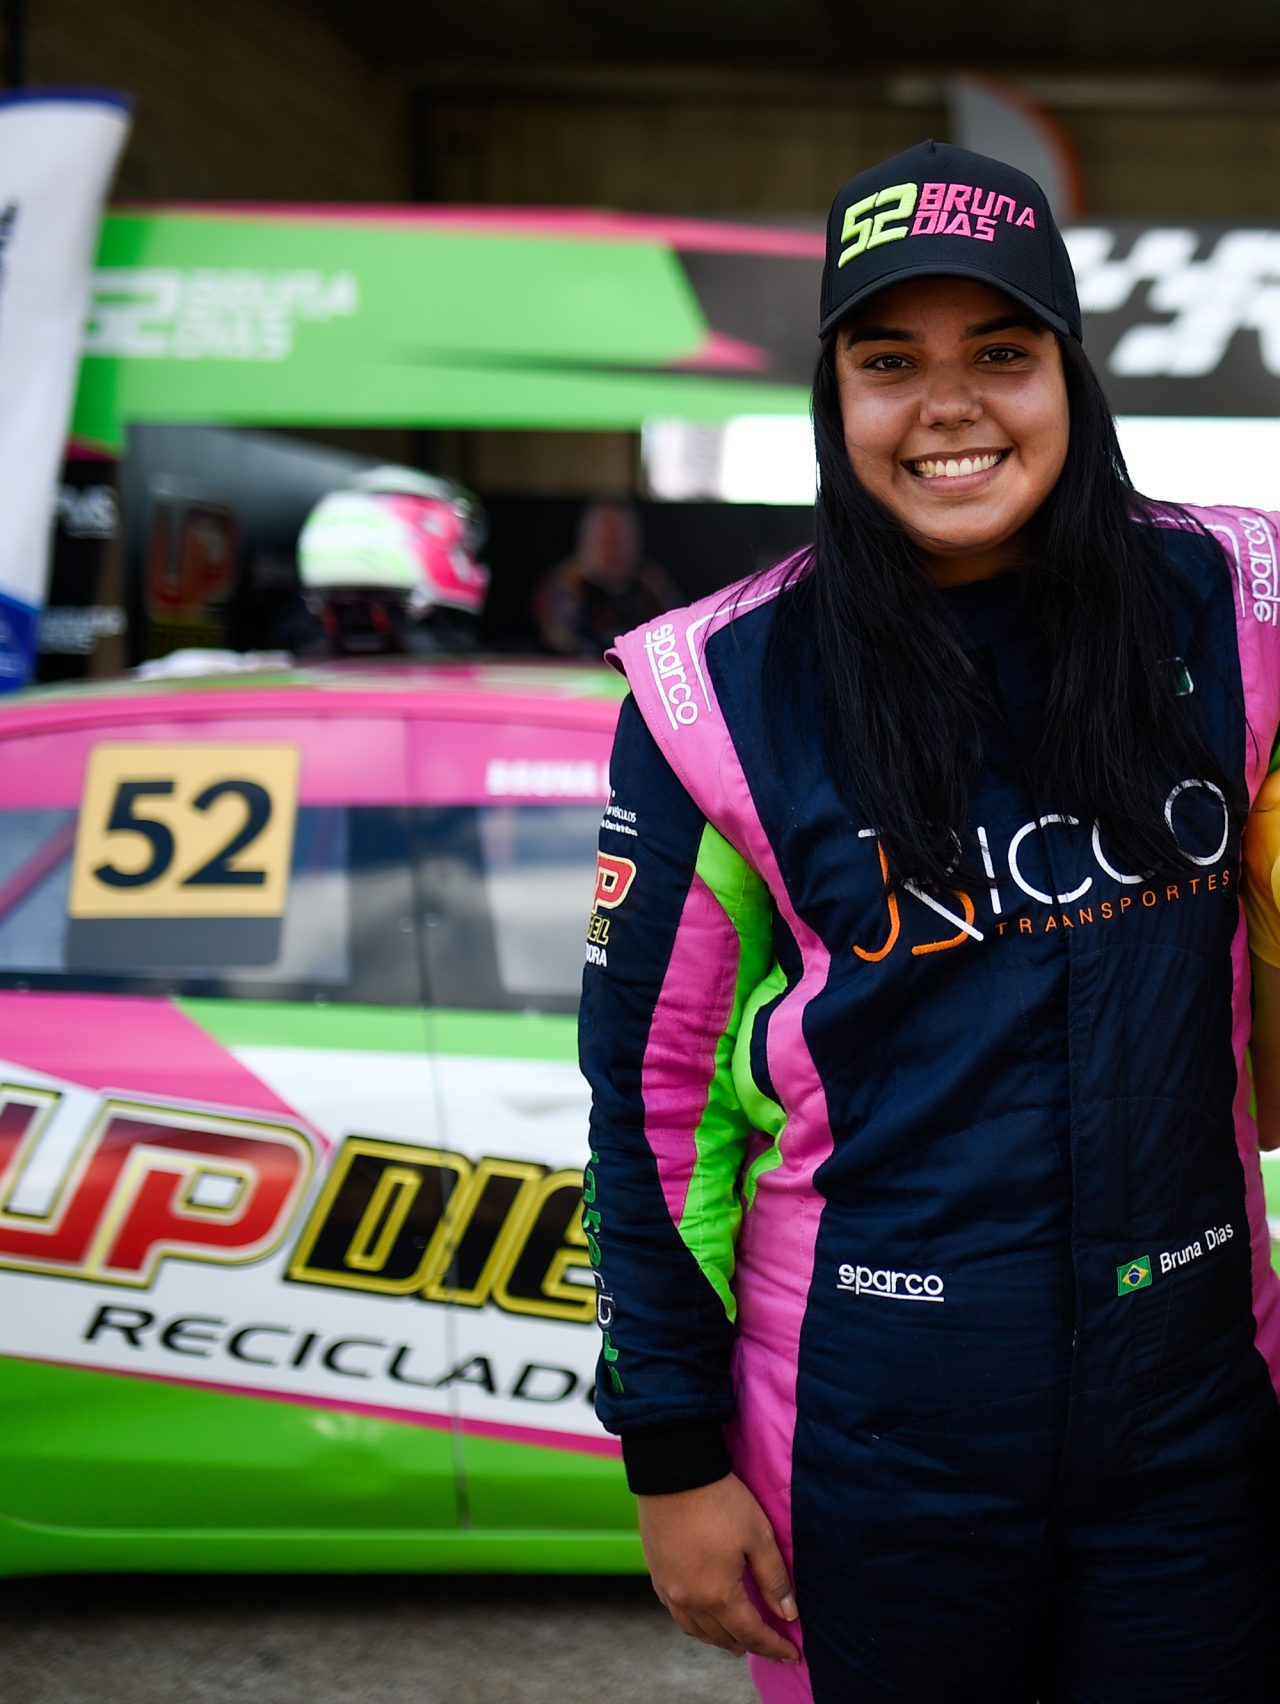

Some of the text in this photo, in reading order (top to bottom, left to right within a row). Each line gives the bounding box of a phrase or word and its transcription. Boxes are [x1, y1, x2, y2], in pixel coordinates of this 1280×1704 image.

[838, 182, 918, 268] 52
[910, 210, 998, 242] DIAS
[917, 182, 1036, 229] BRUNA
[1239, 516, 1280, 626] sparco
[643, 623, 699, 731] sparco
[93, 779, 273, 888] 52
[995, 869, 1231, 934] TRANSPORTES
[0, 1082, 316, 1290] UP
[837, 1263, 944, 1302] sparco
[1160, 1222, 1234, 1274] Bruna Dias
[84, 1305, 596, 1403] RECICLAD
